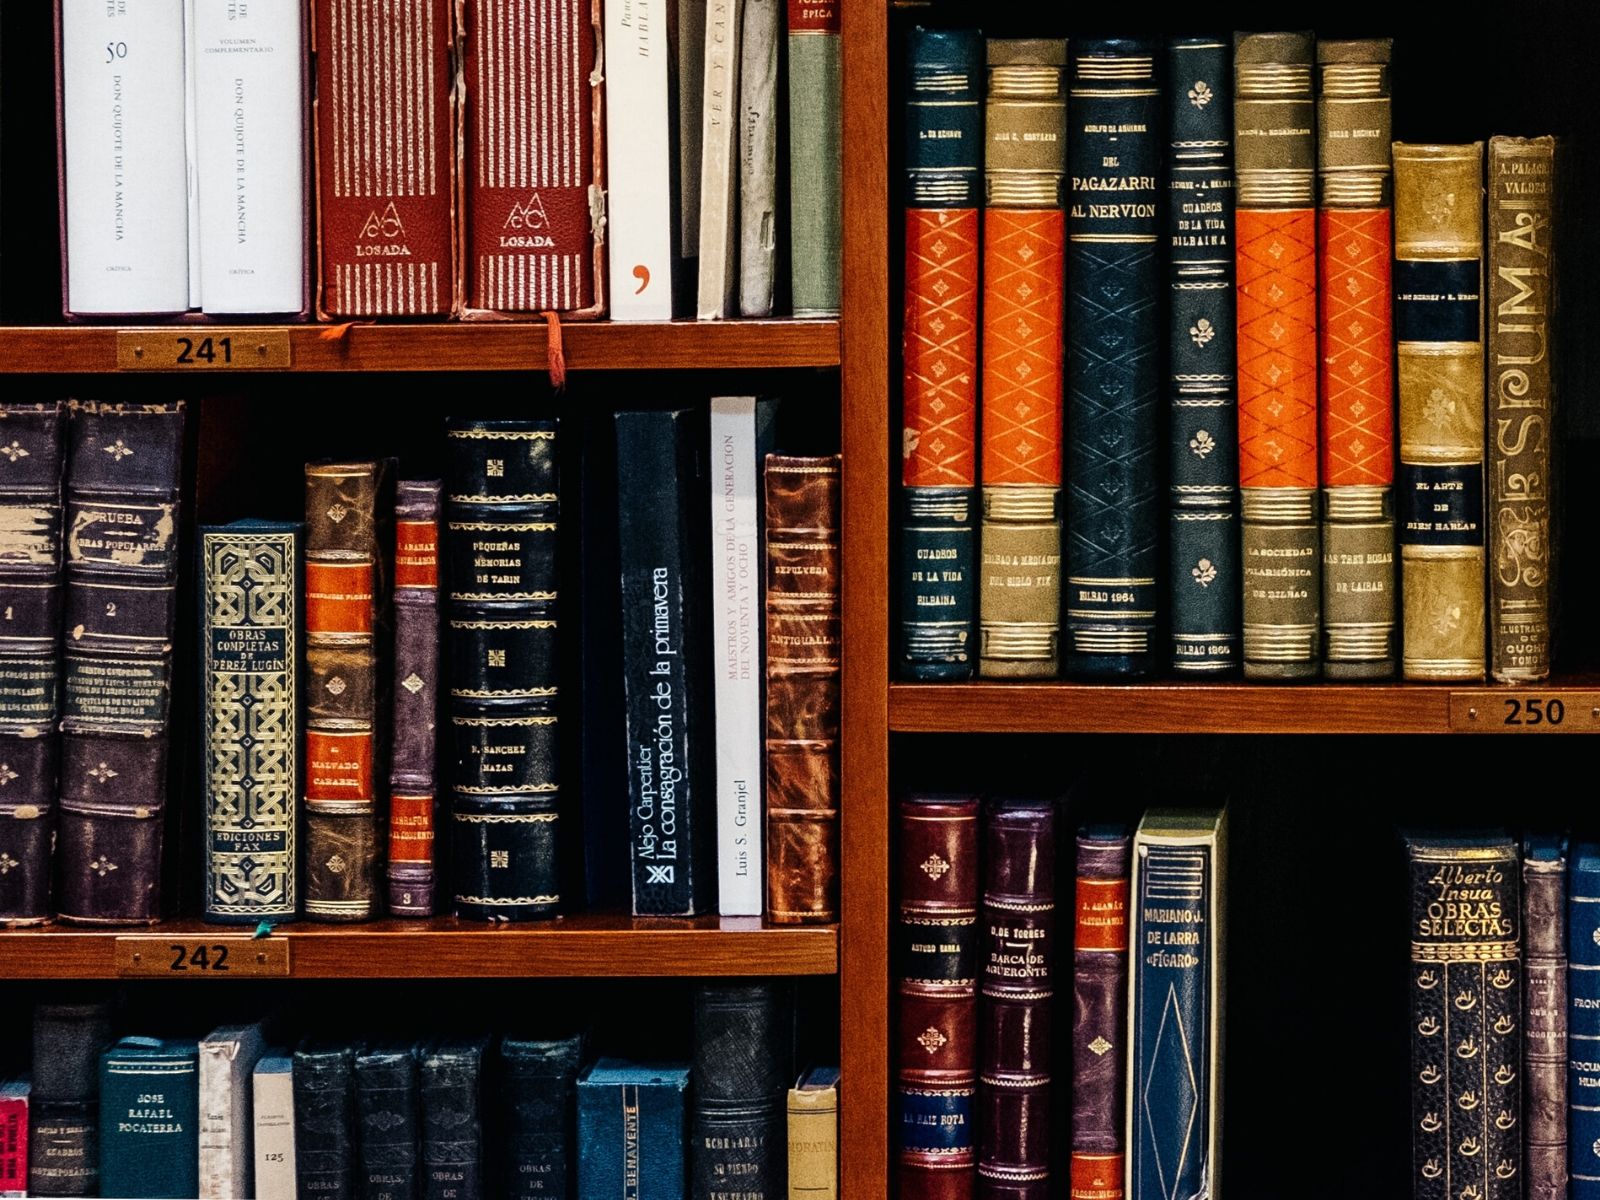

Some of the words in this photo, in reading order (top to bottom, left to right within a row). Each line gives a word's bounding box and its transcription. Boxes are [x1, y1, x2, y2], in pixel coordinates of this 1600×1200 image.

[106, 42, 128, 64] 50
[113, 75, 122, 101] DON
[235, 78, 243, 104] DON
[112, 104, 122, 151] QUIJOTE
[233, 108, 244, 155] QUIJOTE
[114, 155, 123, 170] DE
[236, 159, 245, 173] DE
[1102, 157, 1120, 168] DEL
[114, 174, 123, 188] LA
[237, 177, 245, 191] LA
[1072, 177, 1155, 191] PAGAZARRI
[1070, 206, 1086, 218] AL
[1090, 204, 1155, 218] NERVION
[1182, 203, 1222, 213] CUADROS
[115, 191, 124, 241] MANCHA
[237, 194, 246, 244] MANCHA
[1179, 220, 1190, 230] DE
[1190, 220, 1202, 230] LA
[1205, 219, 1225, 230] VIDA
[500, 236, 555, 247] LOSADA
[1172, 236, 1227, 247] BILBAINA
[356, 245, 411, 256] LOSADA
[176, 338, 233, 364] 241
[723, 434, 735, 512] GENERACION
[1416, 482, 1430, 491] EL
[1434, 482, 1464, 491] ARTE
[1434, 503, 1449, 512] DE
[725, 517, 735, 529] LA
[725, 533, 735, 549] DE
[917, 549, 957, 560] CUADROS
[1261, 548, 1313, 557] SOCIEDAD
[474, 558, 521, 567] MEMORIAS
[737, 543, 748, 579] OCHO
[476, 574, 489, 584] DE
[491, 574, 520, 584] TARIN
[726, 553, 736, 601] AMIGOS
[912, 572, 924, 582] DE
[926, 572, 939, 582] LA
[942, 571, 962, 582] VIDA
[738, 587, 748, 597] Y
[5, 606, 13, 620] 1
[106, 603, 116, 616] 2
[650, 567, 677, 655] primavera
[727, 606, 737, 614] Y
[229, 630, 266, 641] OBRAS
[739, 602, 749, 659] NOVENTA
[217, 640, 279, 652] COMPLETAS
[727, 622, 738, 680] MAESTROS
[240, 652, 254, 660] DE
[213, 658, 247, 671] PÉREZ
[252, 657, 285, 671] LUGÍN
[650, 660, 670, 678] la
[740, 662, 750, 680] DEL
[654, 681, 672, 710] de
[1503, 699, 1565, 726] 250
[483, 744, 526, 755] SANCHEZ
[653, 714, 682, 836] consagración
[635, 744, 659, 822] Carpentier
[733, 779, 753, 829] Granjel
[216, 832, 280, 843] EDICIONES
[638, 823, 659, 860] Alejo
[735, 833, 748, 846] S.
[234, 842, 261, 852] FAX
[655, 839, 677, 860] La
[735, 844, 749, 878] Luis
[1428, 866, 1503, 885] Alberto
[403, 892, 411, 904] 3
[1438, 884, 1494, 901] Insua
[1144, 908, 1192, 923] MARIANO
[1193, 909, 1204, 922] J.
[1428, 902, 1501, 920] OBRAS
[1013, 928, 1045, 939] TORRES
[1419, 919, 1512, 937] SELECTAS
[1147, 931, 1161, 944] DE
[1164, 932, 1200, 945] LARRA
[170, 944, 230, 971] 242
[991, 954, 1026, 965] BARCA
[1028, 955, 1044, 965] DE
[1146, 949, 1199, 968] «FÍGARO»
[137, 1094, 164, 1103] JOSE
[128, 1109, 173, 1119] RAFAEL
[940, 1114, 965, 1125] ROTA
[118, 1123, 183, 1133] POCATERRA
[626, 1106, 637, 1187] BENAVENTE
[265, 1152, 284, 1163] 125
